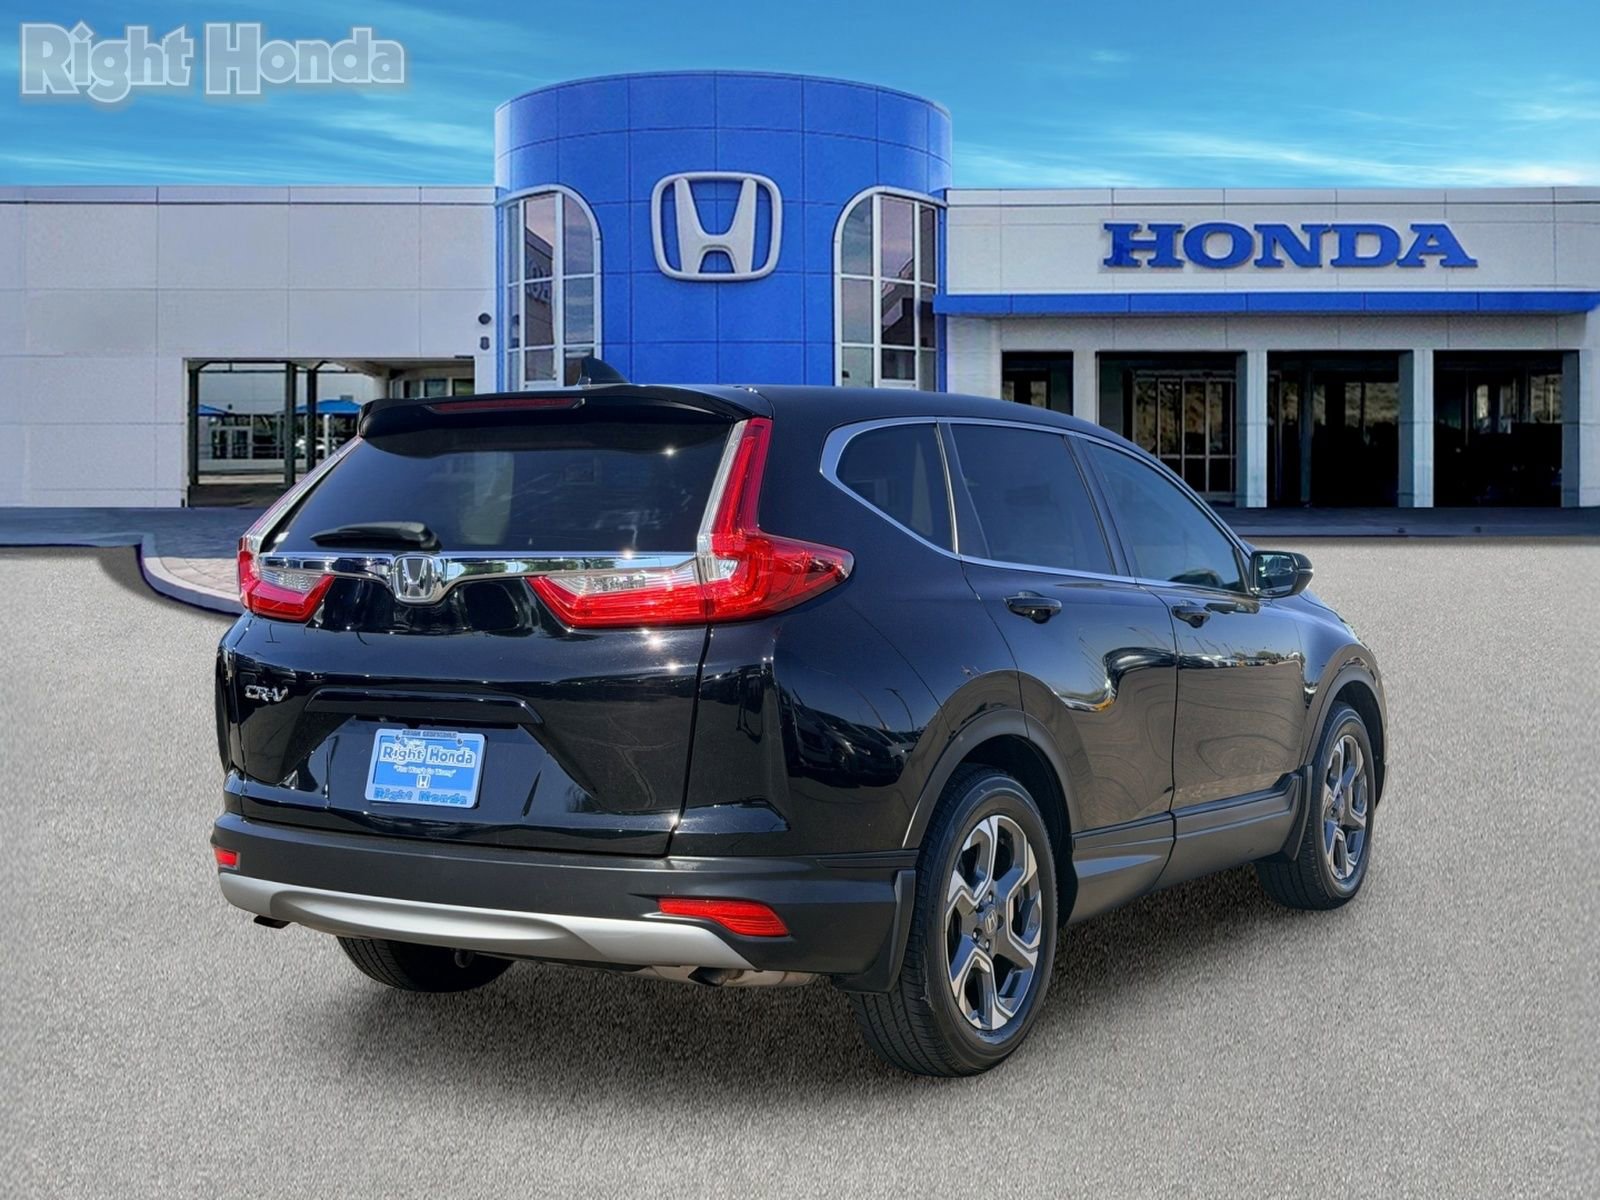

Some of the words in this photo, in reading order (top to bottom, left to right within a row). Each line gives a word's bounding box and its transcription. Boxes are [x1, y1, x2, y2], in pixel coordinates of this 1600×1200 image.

[1103, 222, 1478, 268] HONDA
[245, 685, 289, 702] CR-V
[381, 744, 425, 764] Right
[428, 747, 474, 766] Honda
